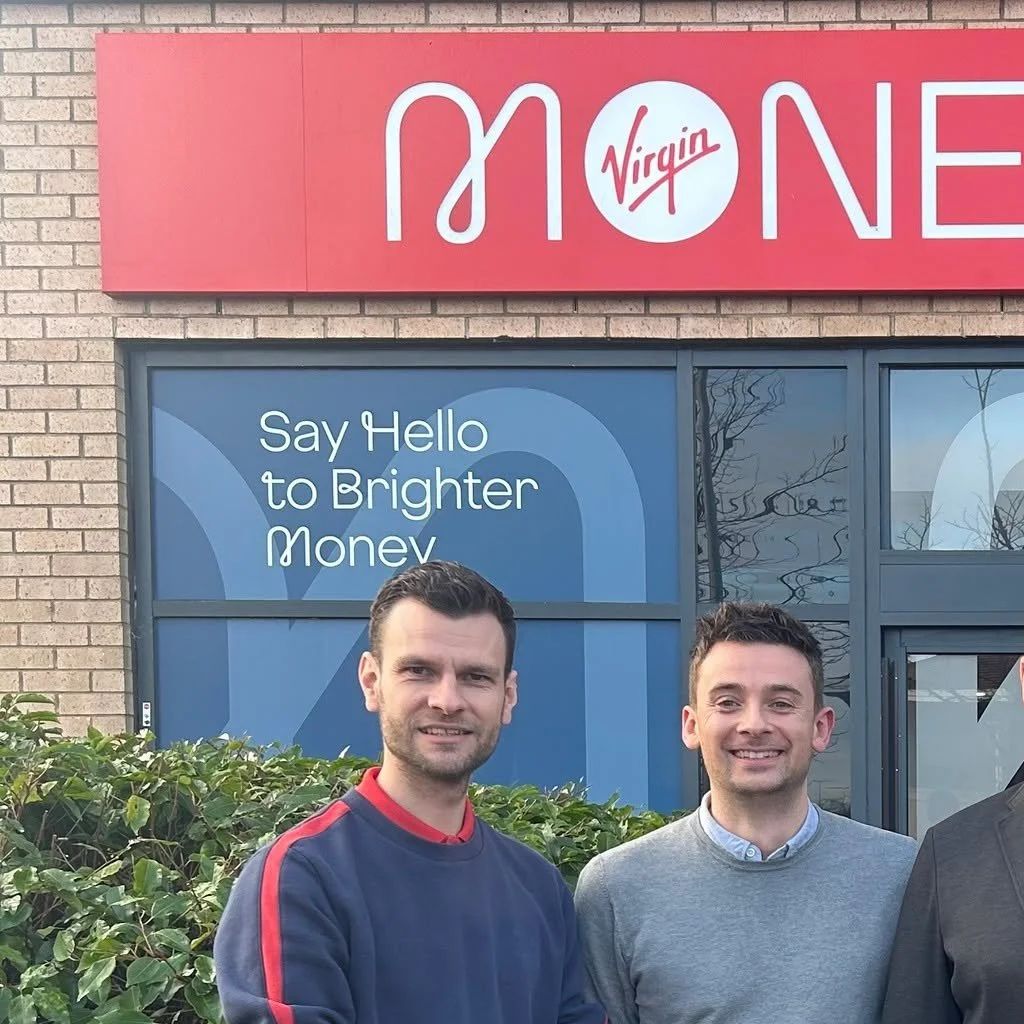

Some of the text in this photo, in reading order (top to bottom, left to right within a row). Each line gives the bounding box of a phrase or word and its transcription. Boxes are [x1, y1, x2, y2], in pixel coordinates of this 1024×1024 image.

[602, 104, 722, 216] Virgin
[259, 408, 489, 463] Say Hello
[261, 466, 540, 521] to Brighter
